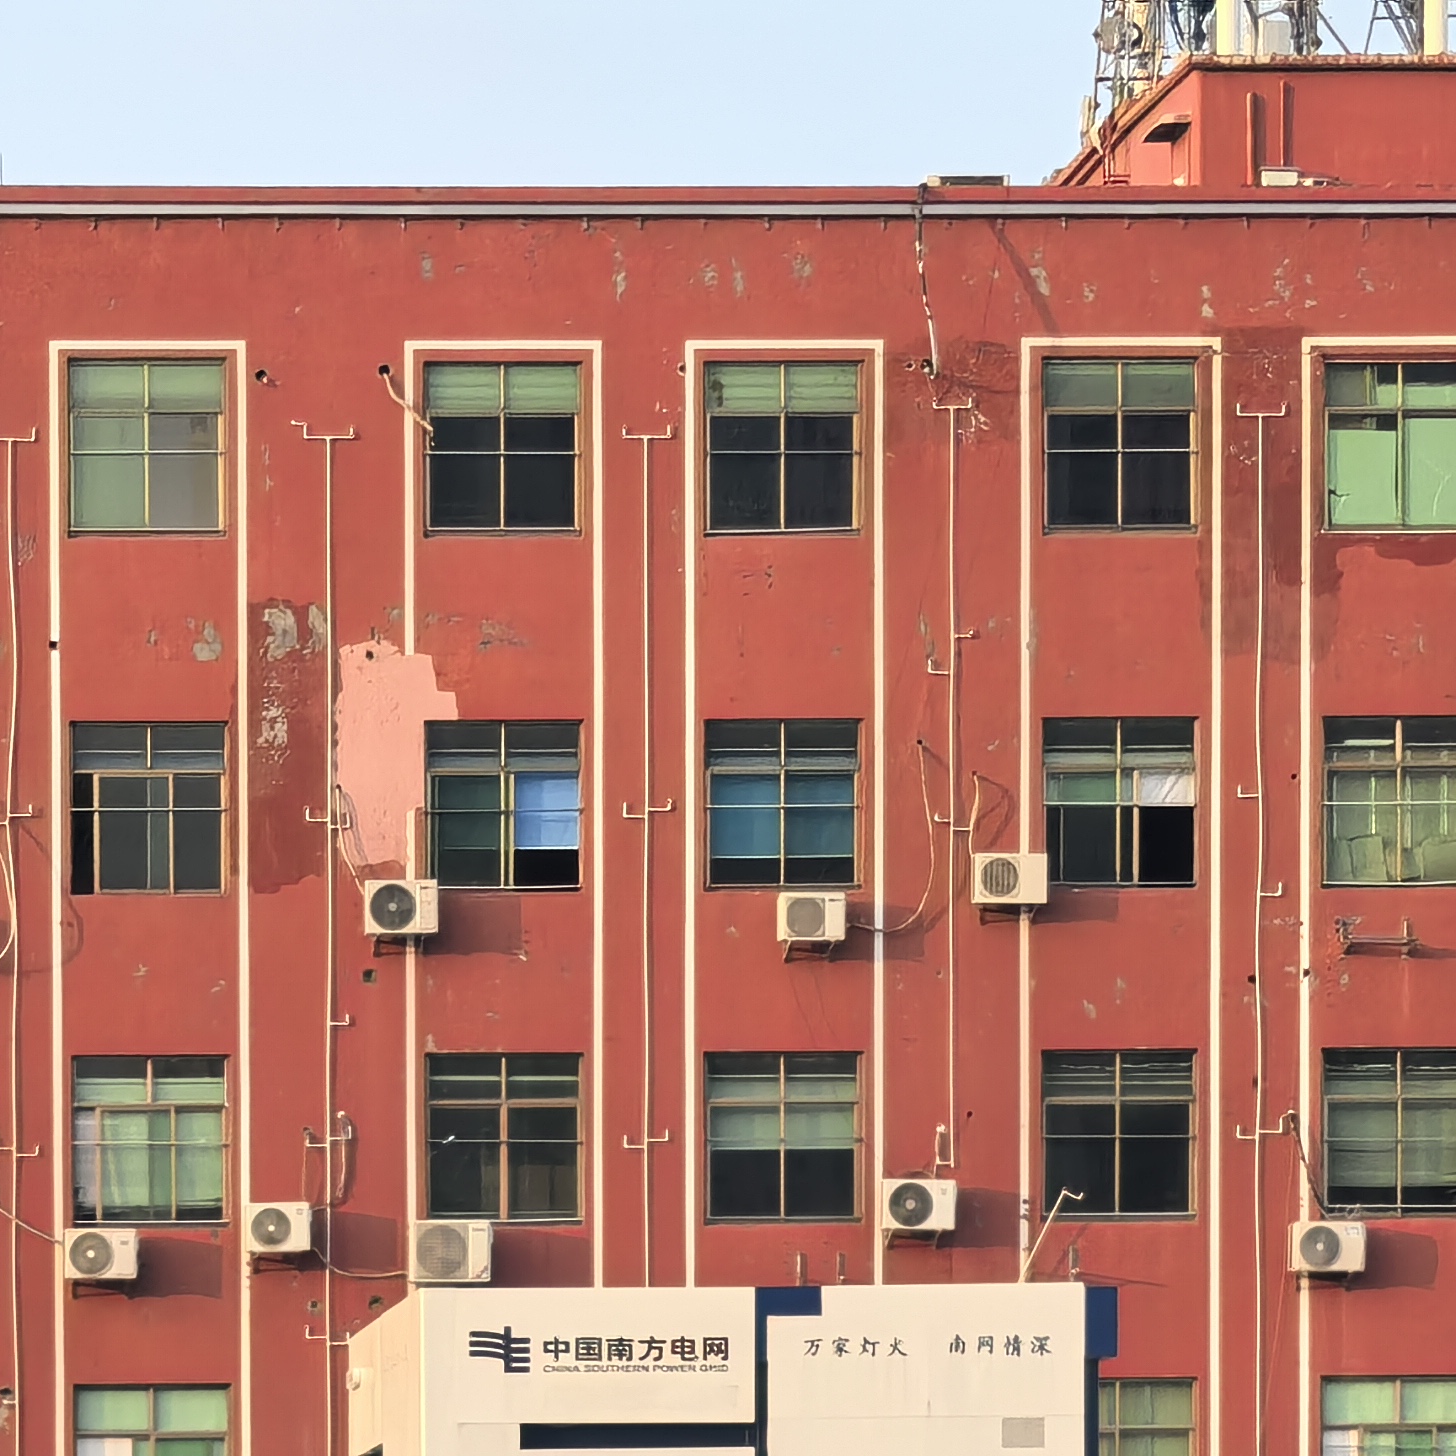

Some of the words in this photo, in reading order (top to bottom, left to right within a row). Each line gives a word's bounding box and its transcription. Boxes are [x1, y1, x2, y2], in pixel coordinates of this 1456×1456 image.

[542, 1335, 730, 1363] 中国南方电网
[803, 1336, 908, 1357] 万家灯火
[949, 1333, 1053, 1358] 南网情深
